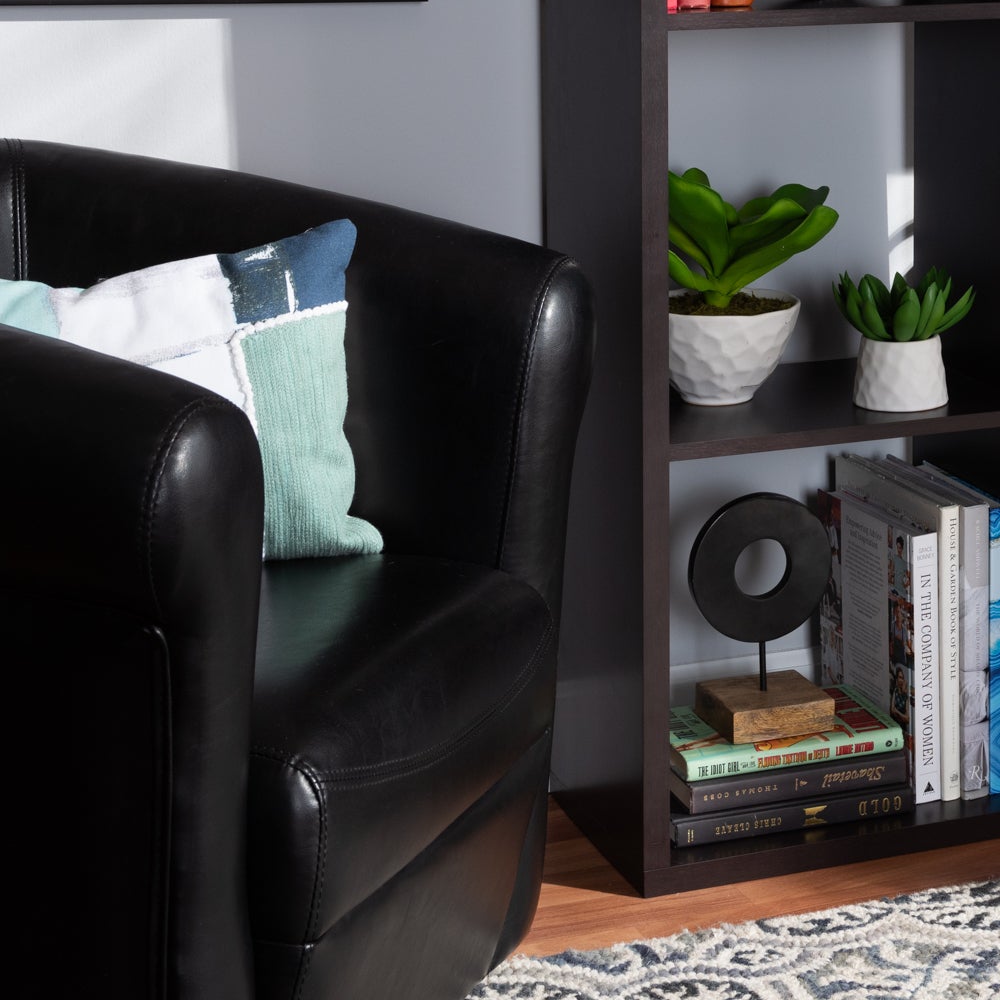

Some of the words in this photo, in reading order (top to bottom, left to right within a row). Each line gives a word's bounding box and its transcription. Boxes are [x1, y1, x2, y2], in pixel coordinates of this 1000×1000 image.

[950, 518, 958, 548] HOUSE
[920, 574, 931, 588] IN
[950, 564, 958, 604] GARDEN
[920, 592, 932, 621] THE
[950, 636, 957, 648] OF
[920, 624, 933, 689] COMPANY
[922, 693, 933, 710] OF
[922, 714, 934, 766] WOMEN
[698, 766, 709, 778] THE
[710, 763, 727, 776] IDIOT
[728, 761, 740, 774] GIRL
[822, 766, 885, 788] Shavetail
[703, 792, 730, 802] COBB
[735, 784, 778, 797] THOMAS
[858, 796, 902, 816] GOLD
[715, 821, 750, 836] CLEAVE
[754, 816, 782, 830] CHRIS
